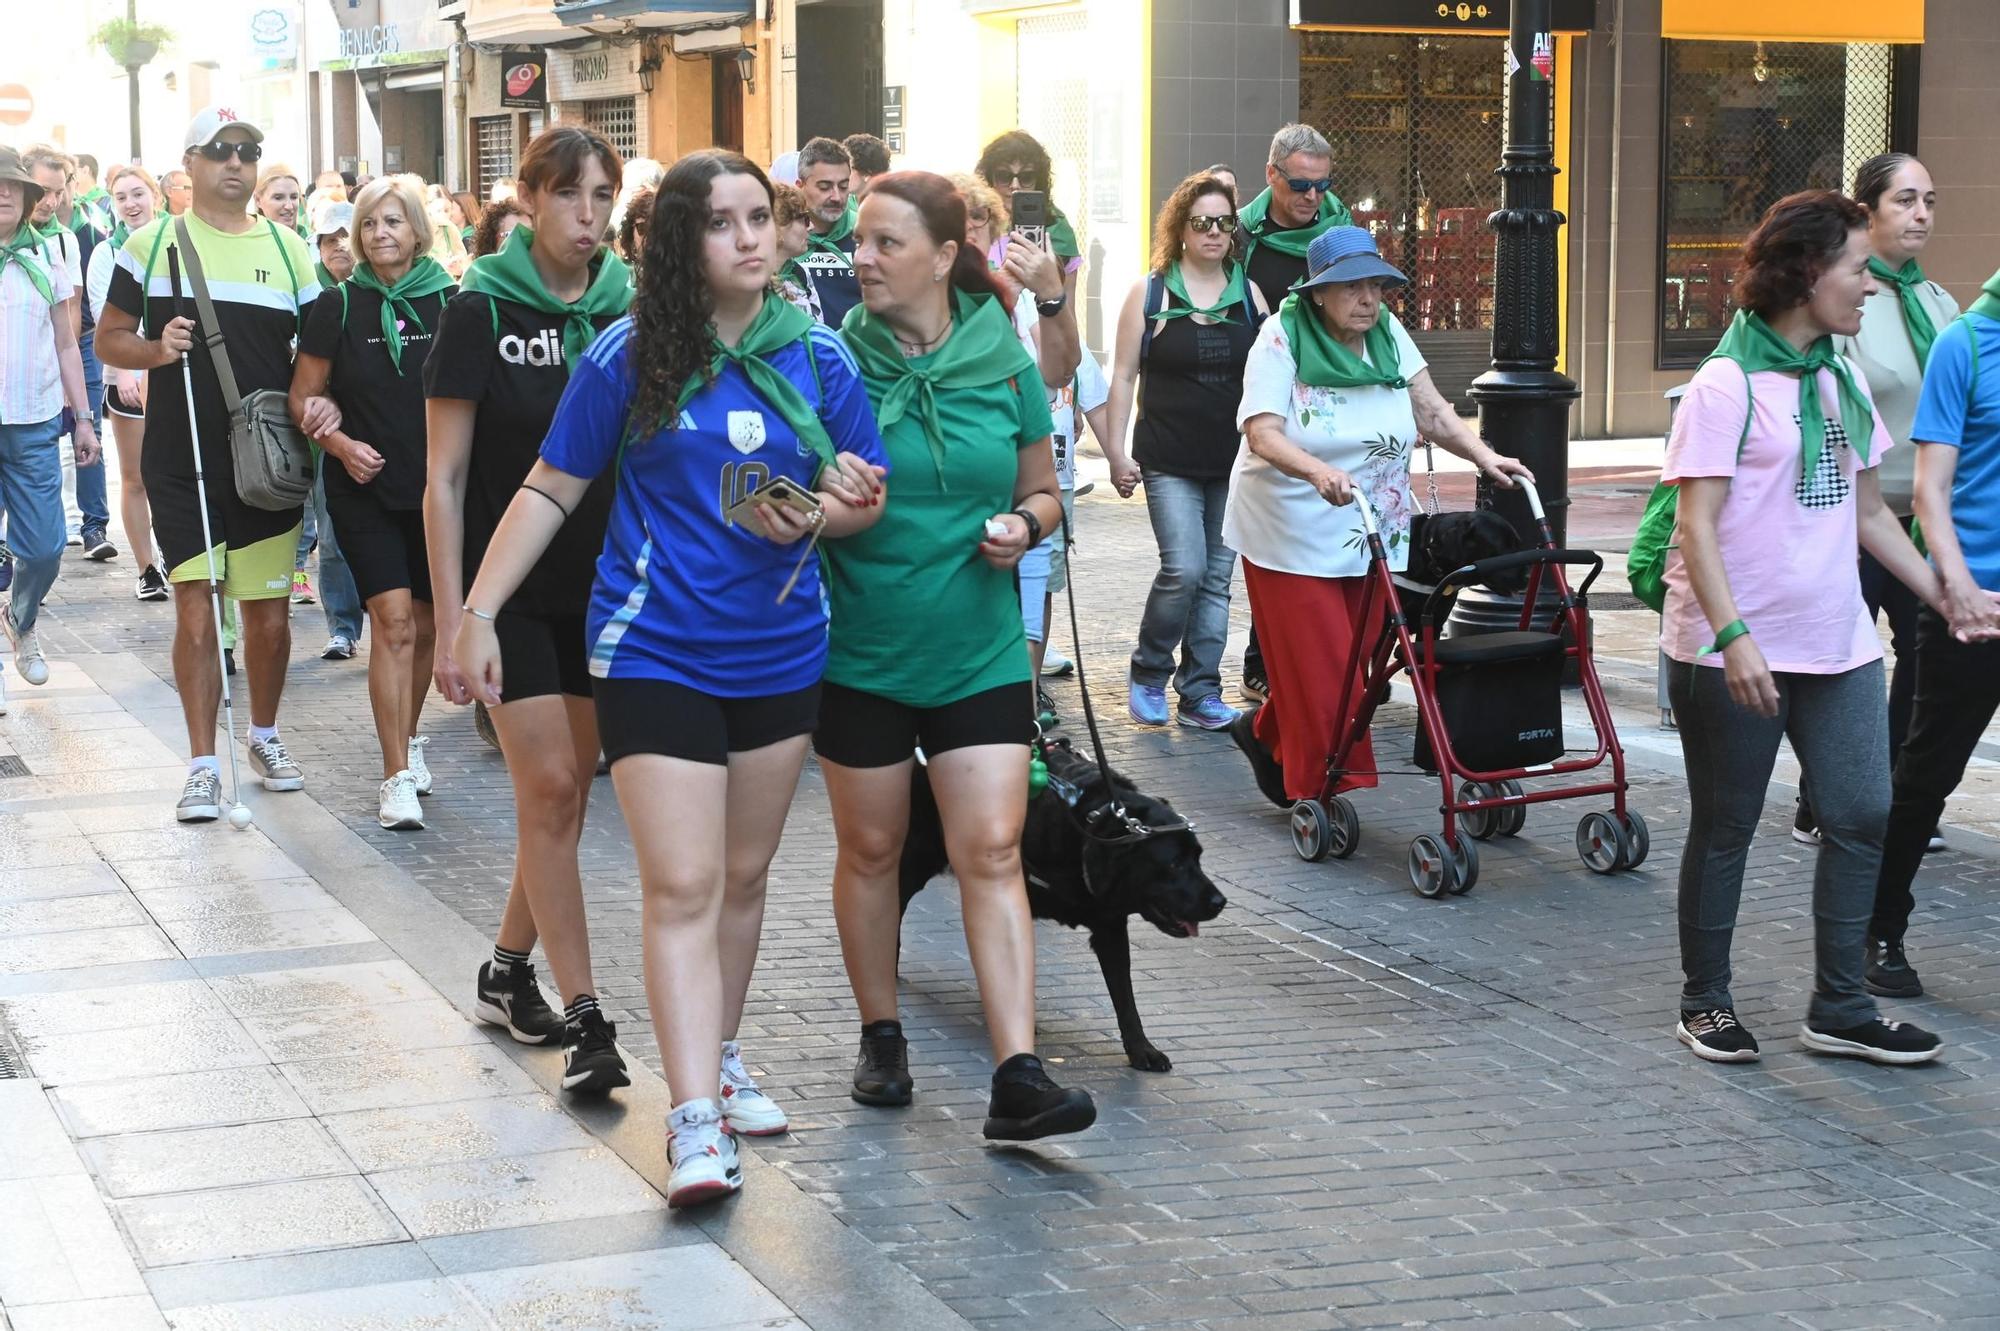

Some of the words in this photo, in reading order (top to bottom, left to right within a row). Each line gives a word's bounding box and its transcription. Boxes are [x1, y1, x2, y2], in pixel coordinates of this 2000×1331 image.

[339, 24, 400, 57] BENAGES
[573, 55, 609, 83] GNOMO
[499, 329, 565, 367] adi
[719, 461, 770, 527] 10
[1519, 729, 1553, 741] FORTA
